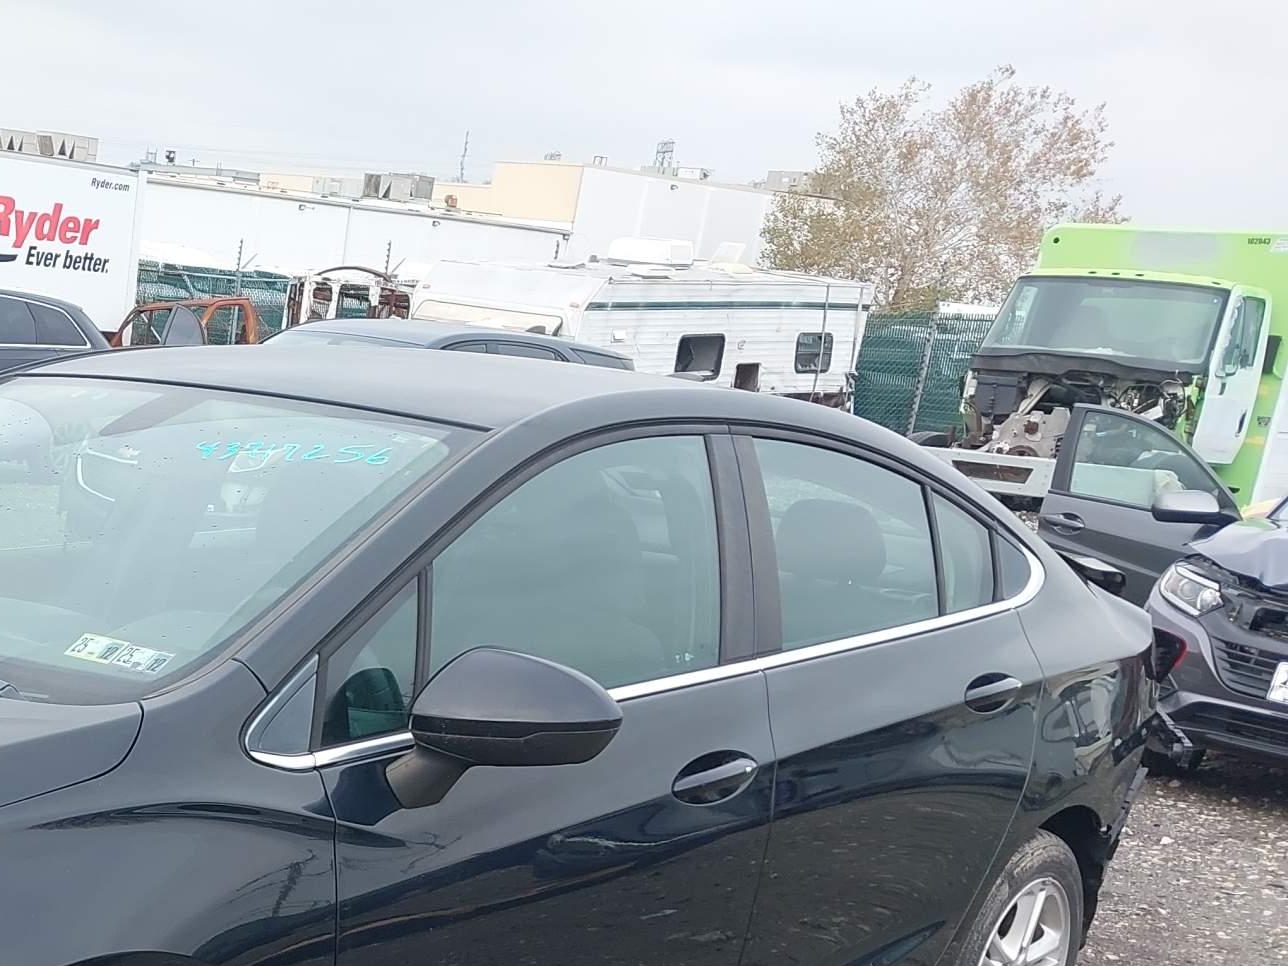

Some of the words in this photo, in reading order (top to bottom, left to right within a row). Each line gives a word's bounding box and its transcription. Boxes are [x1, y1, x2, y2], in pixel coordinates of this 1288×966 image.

[91, 177, 130, 192] Ryder.com
[25, 246, 61, 267] Ever
[62, 250, 110, 273] better.
